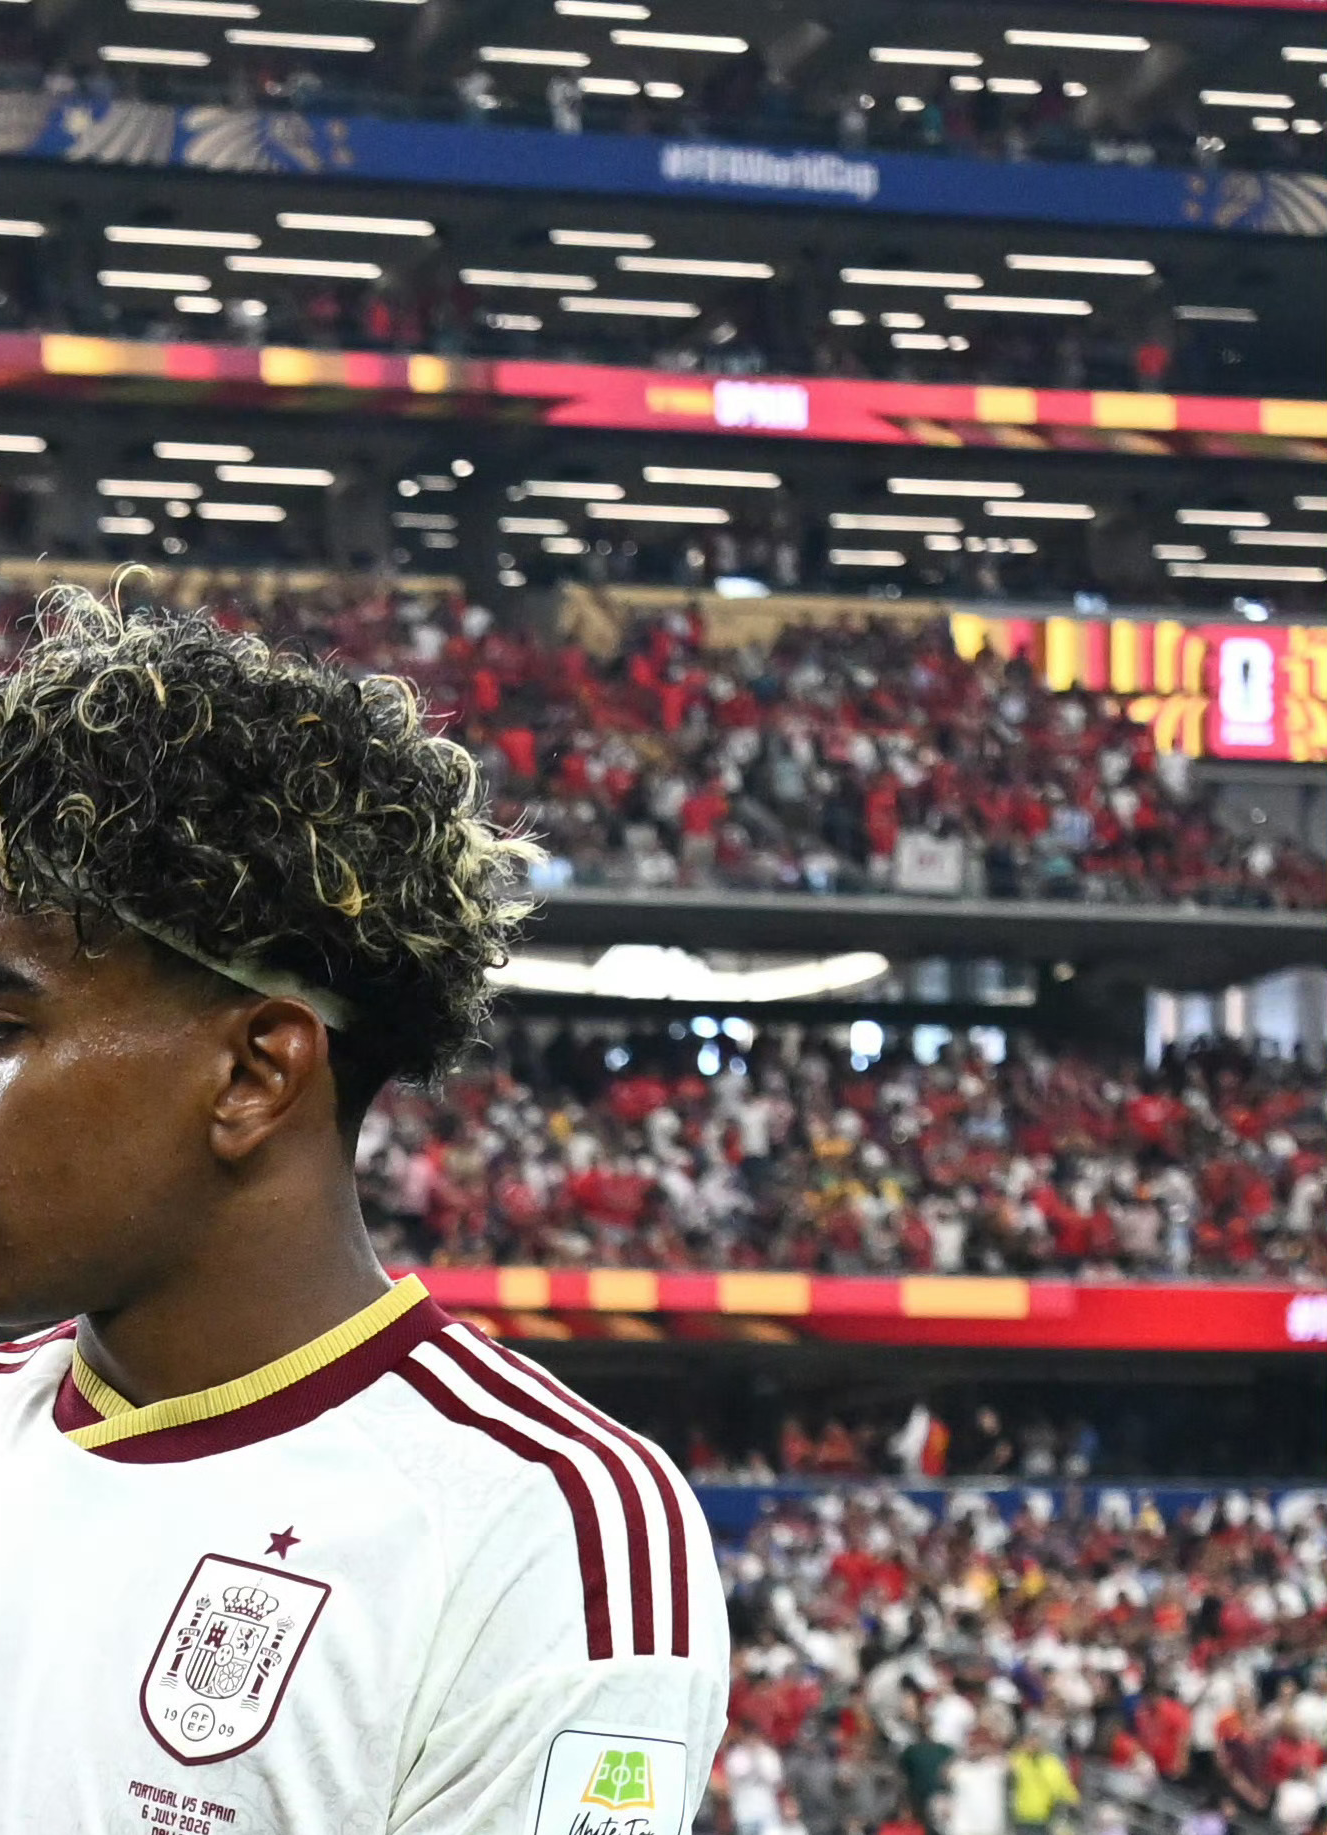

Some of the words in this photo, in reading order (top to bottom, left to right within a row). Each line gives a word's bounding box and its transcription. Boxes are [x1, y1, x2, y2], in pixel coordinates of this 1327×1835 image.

[163, 1707, 178, 1722] 19
[218, 1723, 235, 1738] 09
[128, 1780, 179, 1809] PORTUGAL
[181, 1796, 198, 1812] VS
[200, 1801, 236, 1824] SPAIN
[141, 1804, 149, 1819] 6
[151, 1807, 178, 1826] JULY
[179, 1815, 211, 1835] 2026
